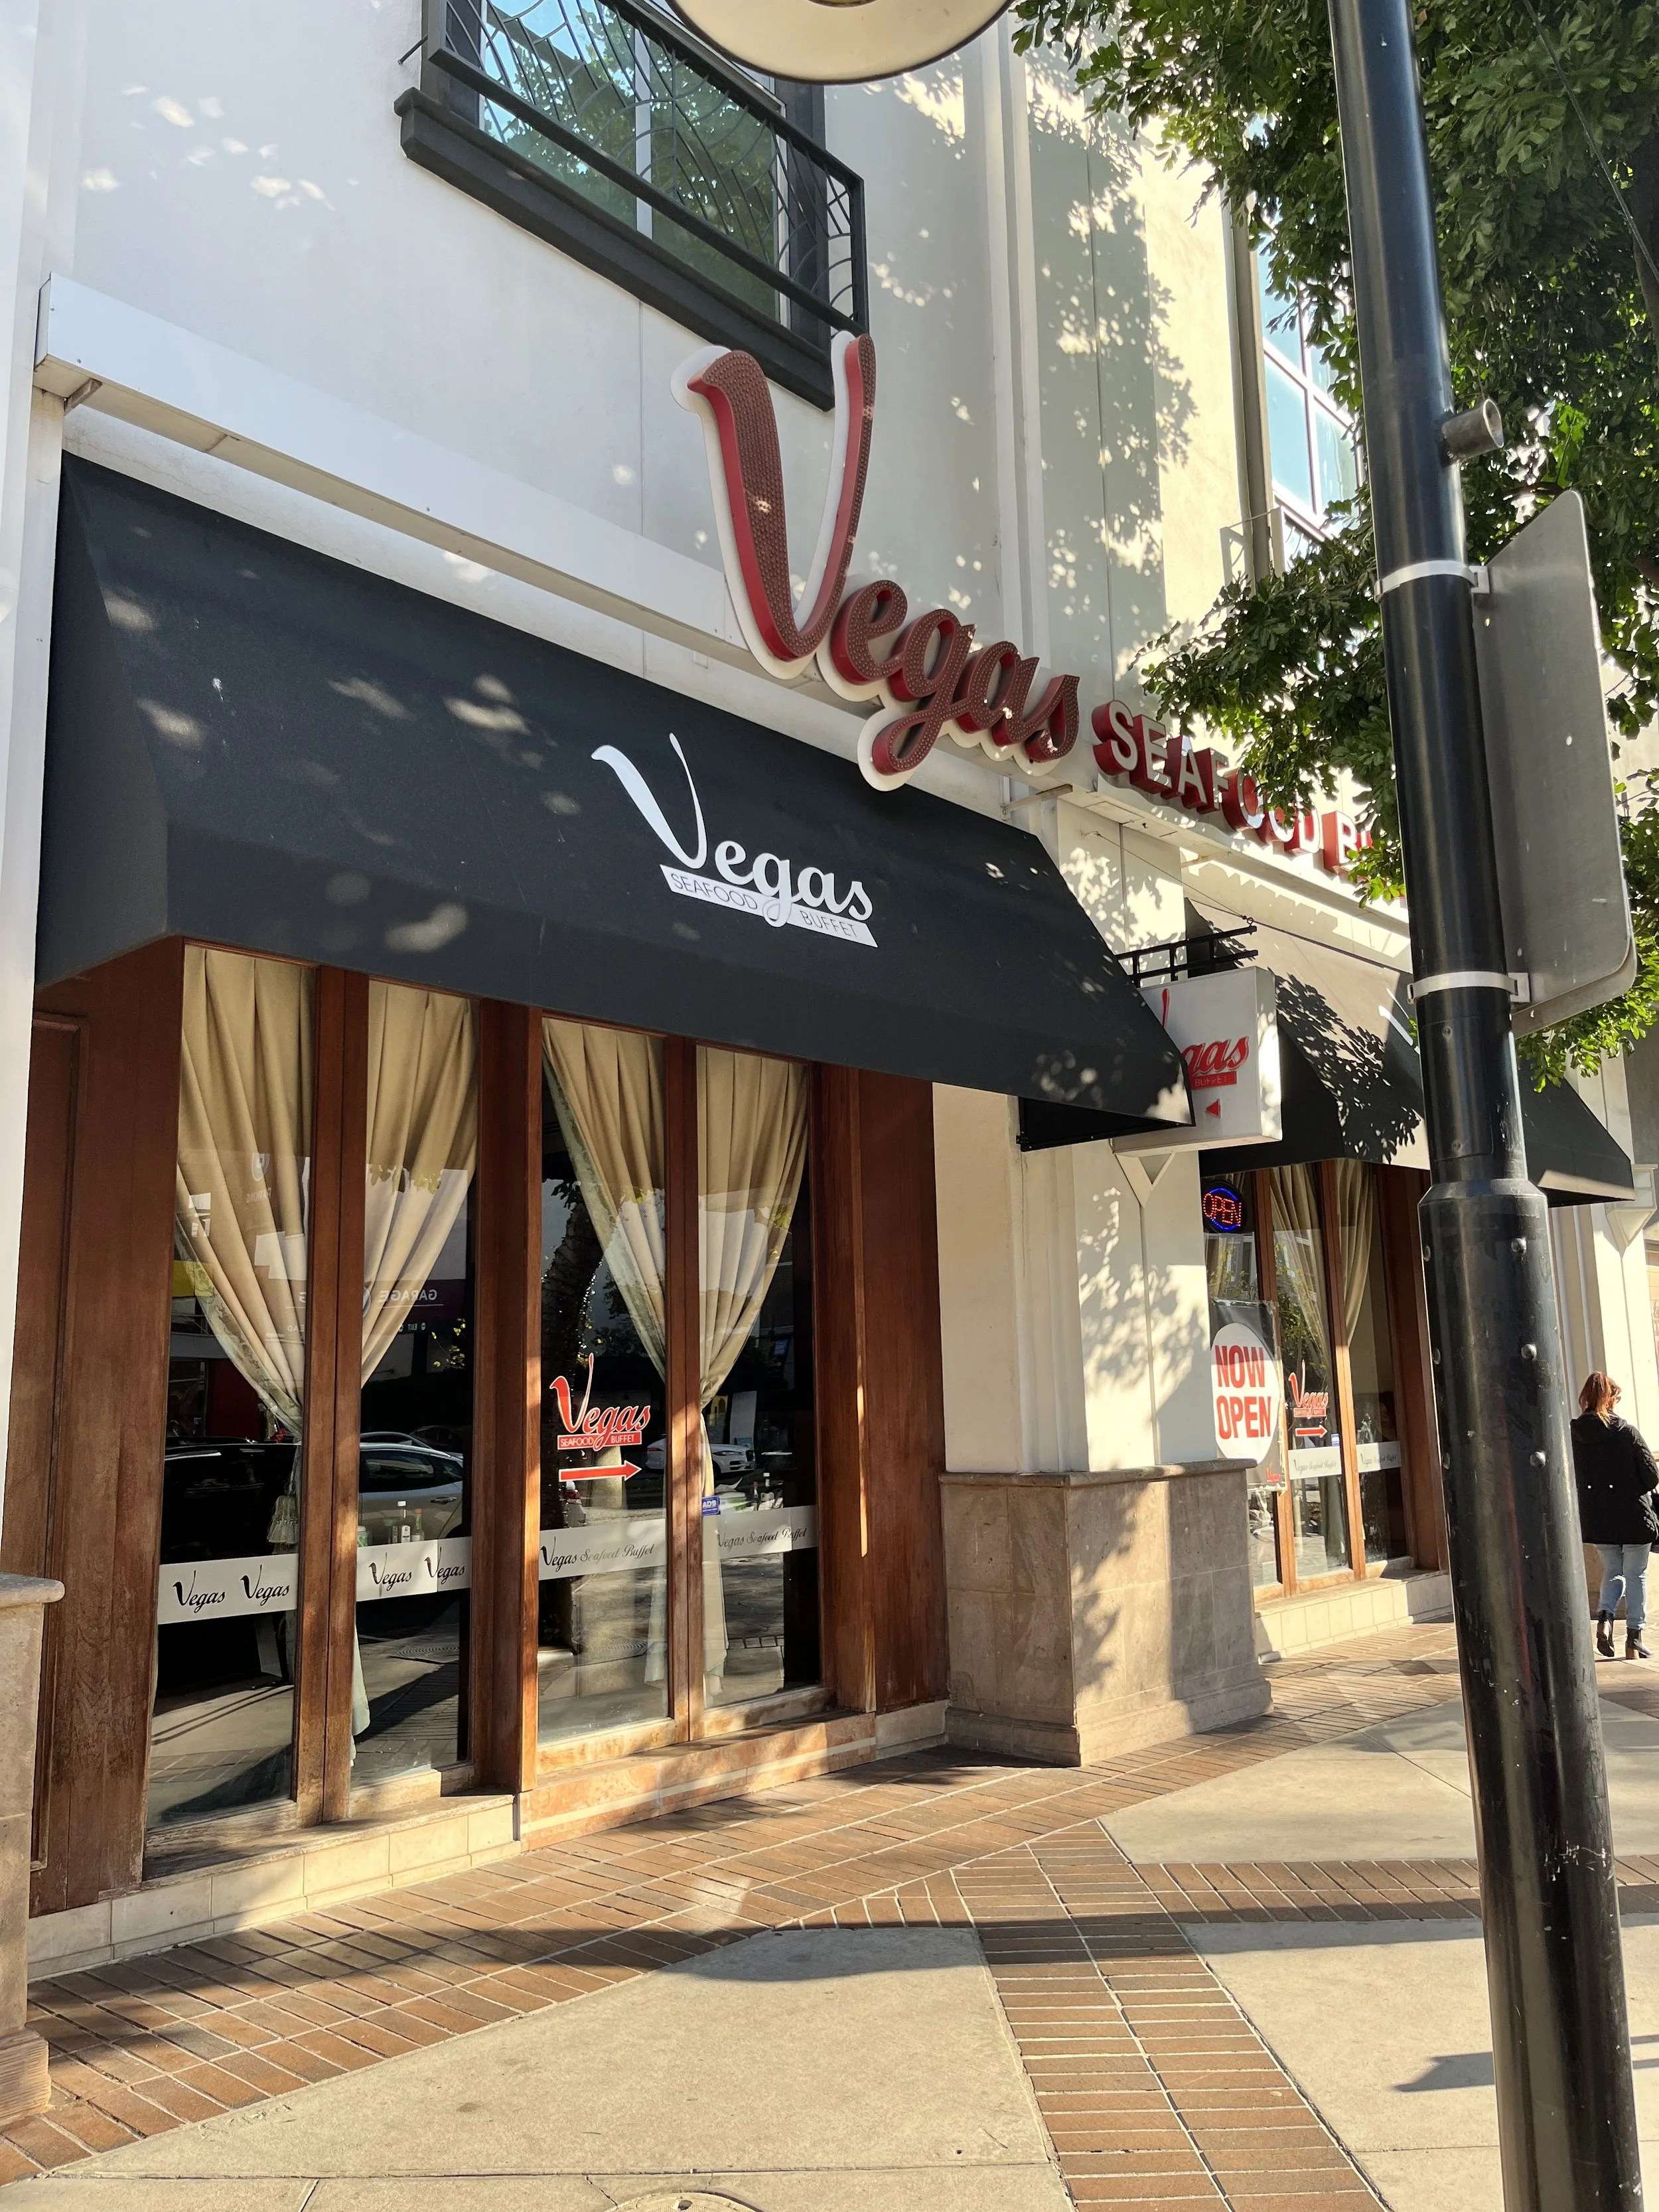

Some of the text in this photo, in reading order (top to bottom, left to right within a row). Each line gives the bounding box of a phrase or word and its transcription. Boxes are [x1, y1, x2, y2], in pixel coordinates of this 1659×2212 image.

[687, 332, 1080, 776] Vegas
[591, 732, 873, 927] Vegas
[671, 873, 858, 938] SEAFOOD BUFFET
[1203, 1193, 1242, 1226] OPEN
[1215, 1345, 1265, 1388] NOW
[1288, 1359, 1329, 1419] Vegas
[549, 1353, 651, 1451] Vegas
[1216, 1395, 1271, 1439] OPEN
[560, 1434, 635, 1447] SEAFOOD BUFFET
[540, 1536, 655, 1572] Vegas Seafood Buffet
[717, 1520, 807, 1553] Vegas Seafood Buffet
[173, 1564, 290, 1613] Vegas Vegas
[369, 1546, 465, 1591] Vegas Vegas
